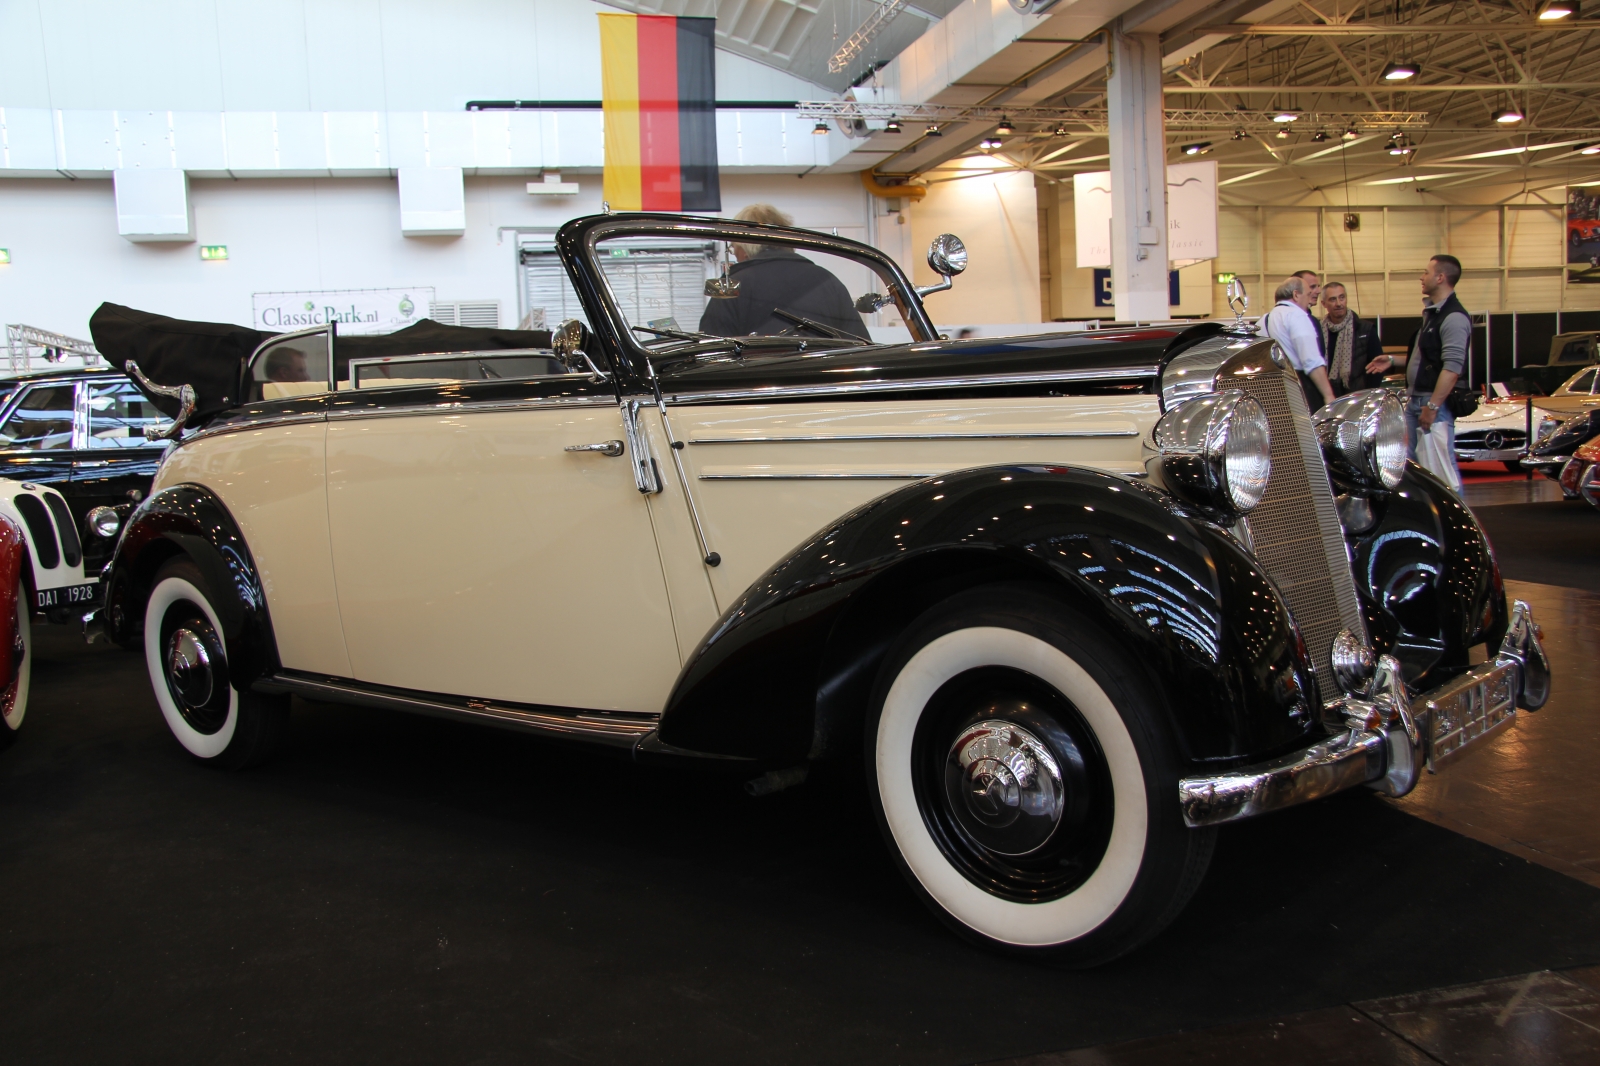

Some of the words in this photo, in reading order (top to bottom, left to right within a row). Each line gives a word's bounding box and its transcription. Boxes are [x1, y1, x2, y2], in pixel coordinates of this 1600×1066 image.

[1090, 246, 1107, 255] The
[1169, 238, 1204, 249] lassic
[68, 585, 93, 602] 1928
